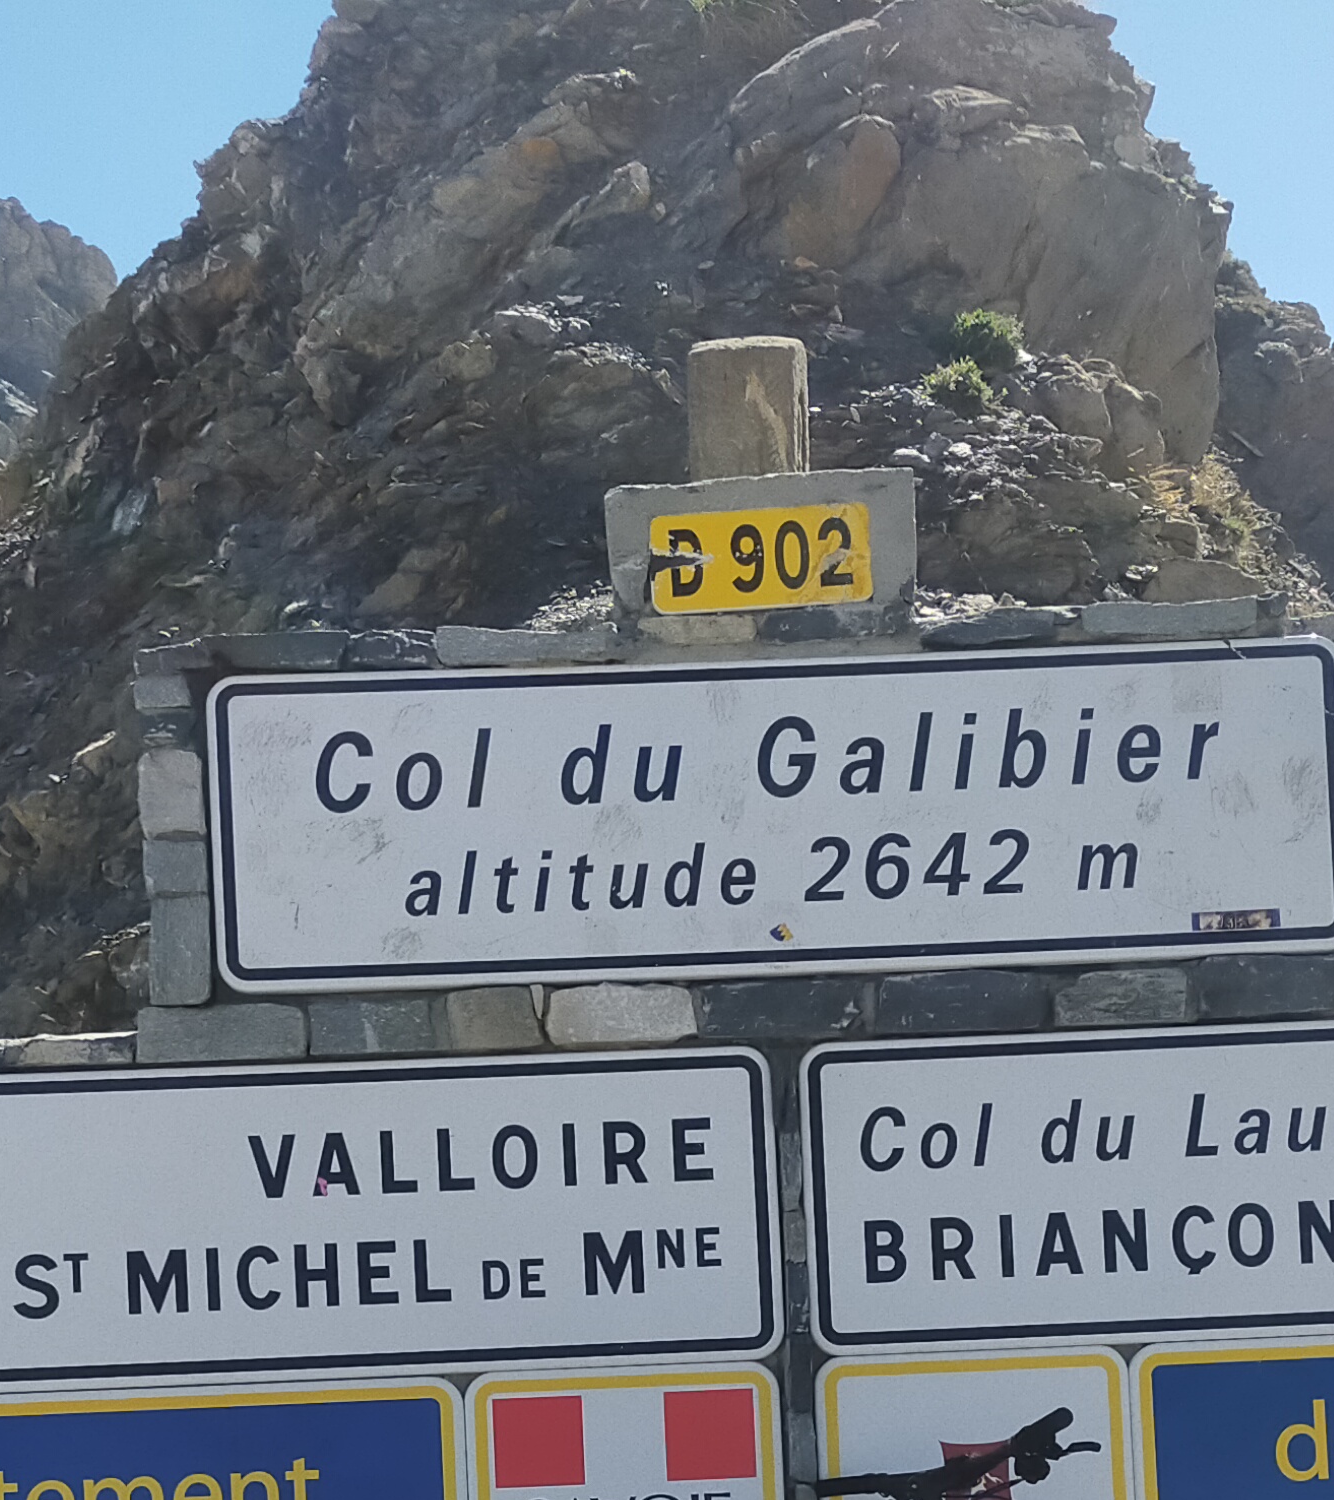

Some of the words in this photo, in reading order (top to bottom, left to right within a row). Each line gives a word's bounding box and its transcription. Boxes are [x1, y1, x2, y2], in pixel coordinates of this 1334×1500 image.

[668, 529, 705, 598] D
[730, 517, 854, 593] 902
[315, 728, 492, 814] Col
[560, 724, 683, 805] du
[758, 708, 1220, 798] Galibier
[405, 843, 757, 916] altitude
[805, 829, 1030, 902] 2642
[1078, 843, 1138, 890] m
[248, 1118, 715, 1199] VALLOIRE
[861, 1103, 993, 1171] Col
[1042, 1099, 1134, 1163] du
[127, 1239, 452, 1315] MICHEL
[483, 1258, 547, 1299] DE
